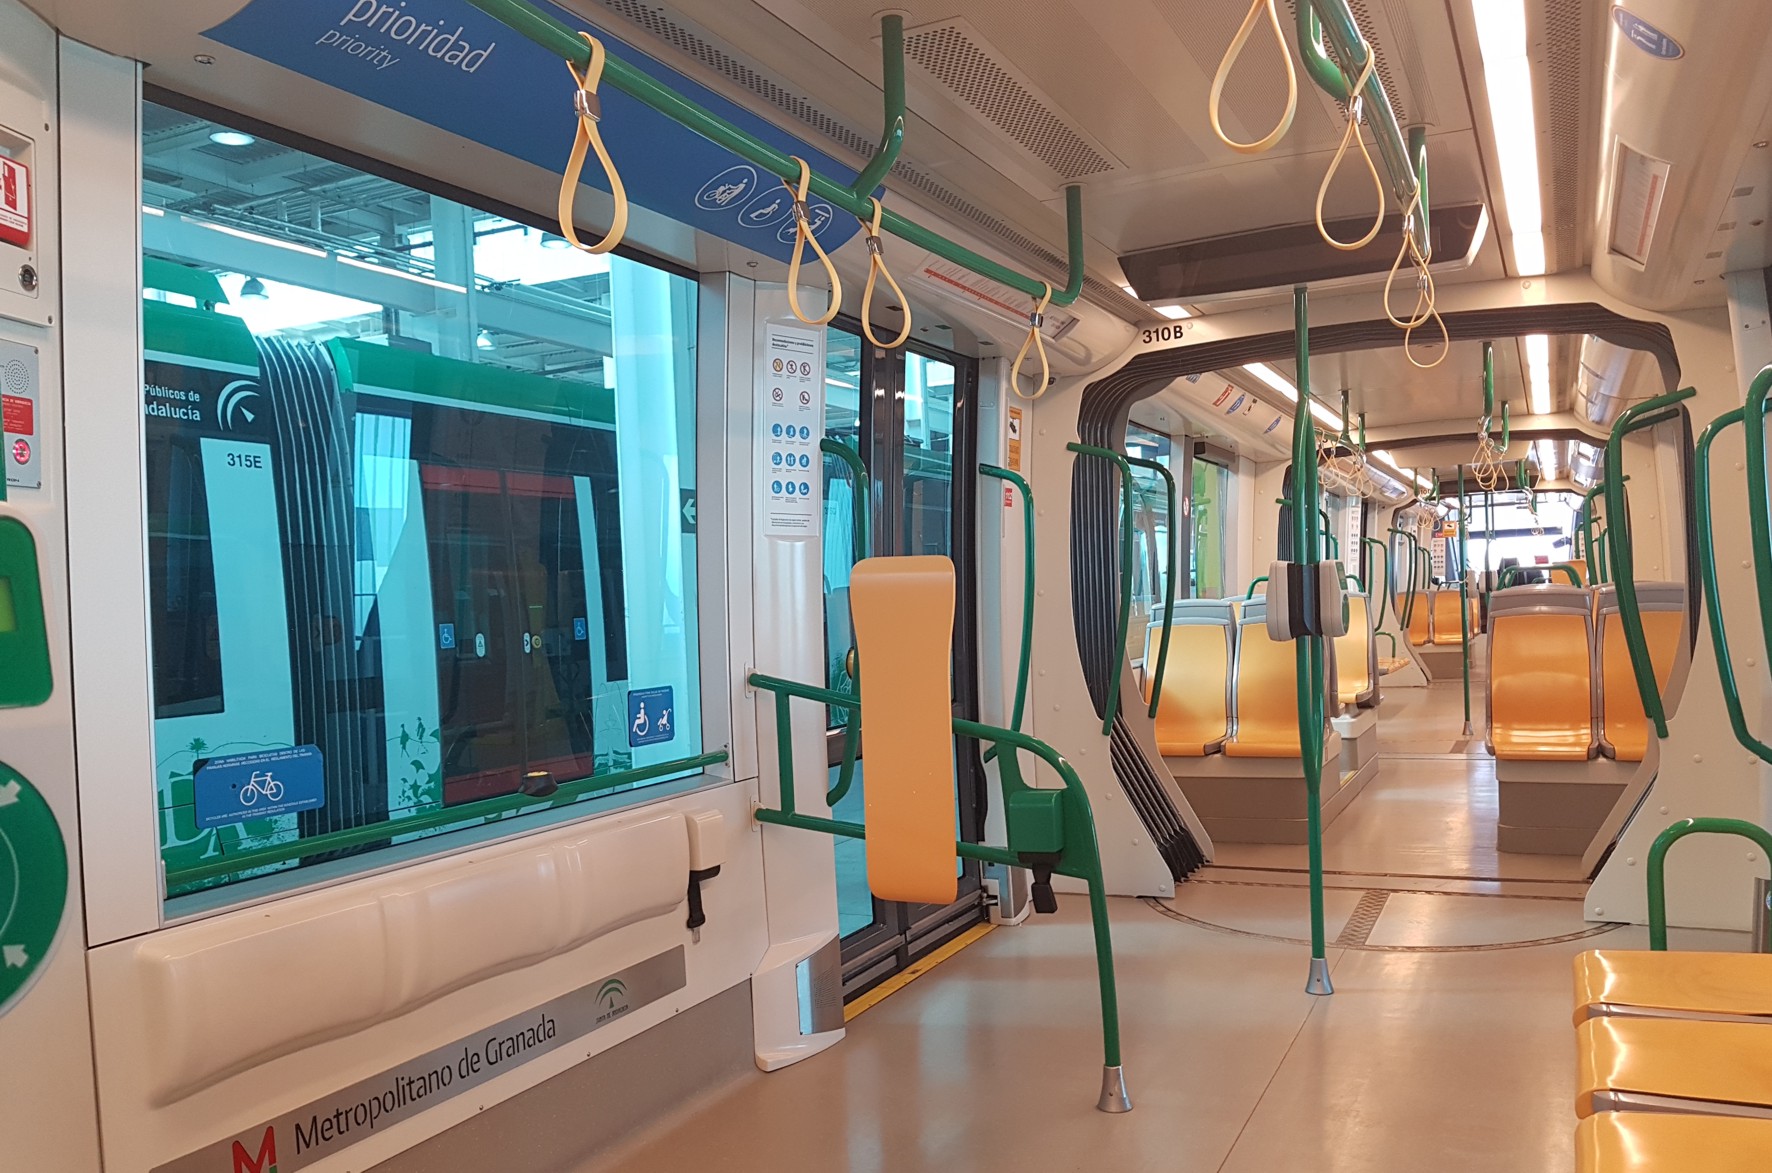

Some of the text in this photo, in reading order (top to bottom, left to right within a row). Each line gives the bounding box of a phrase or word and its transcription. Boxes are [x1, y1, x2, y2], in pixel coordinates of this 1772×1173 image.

[315, 29, 400, 70] priority
[339, 0, 496, 73] prioridad
[144, 384, 200, 402] Públicos de
[227, 453, 262, 469] 315E
[294, 1065, 453, 1155] Metropolitano
[458, 1047, 481, 1079] de
[485, 1013, 556, 1066] Granada
